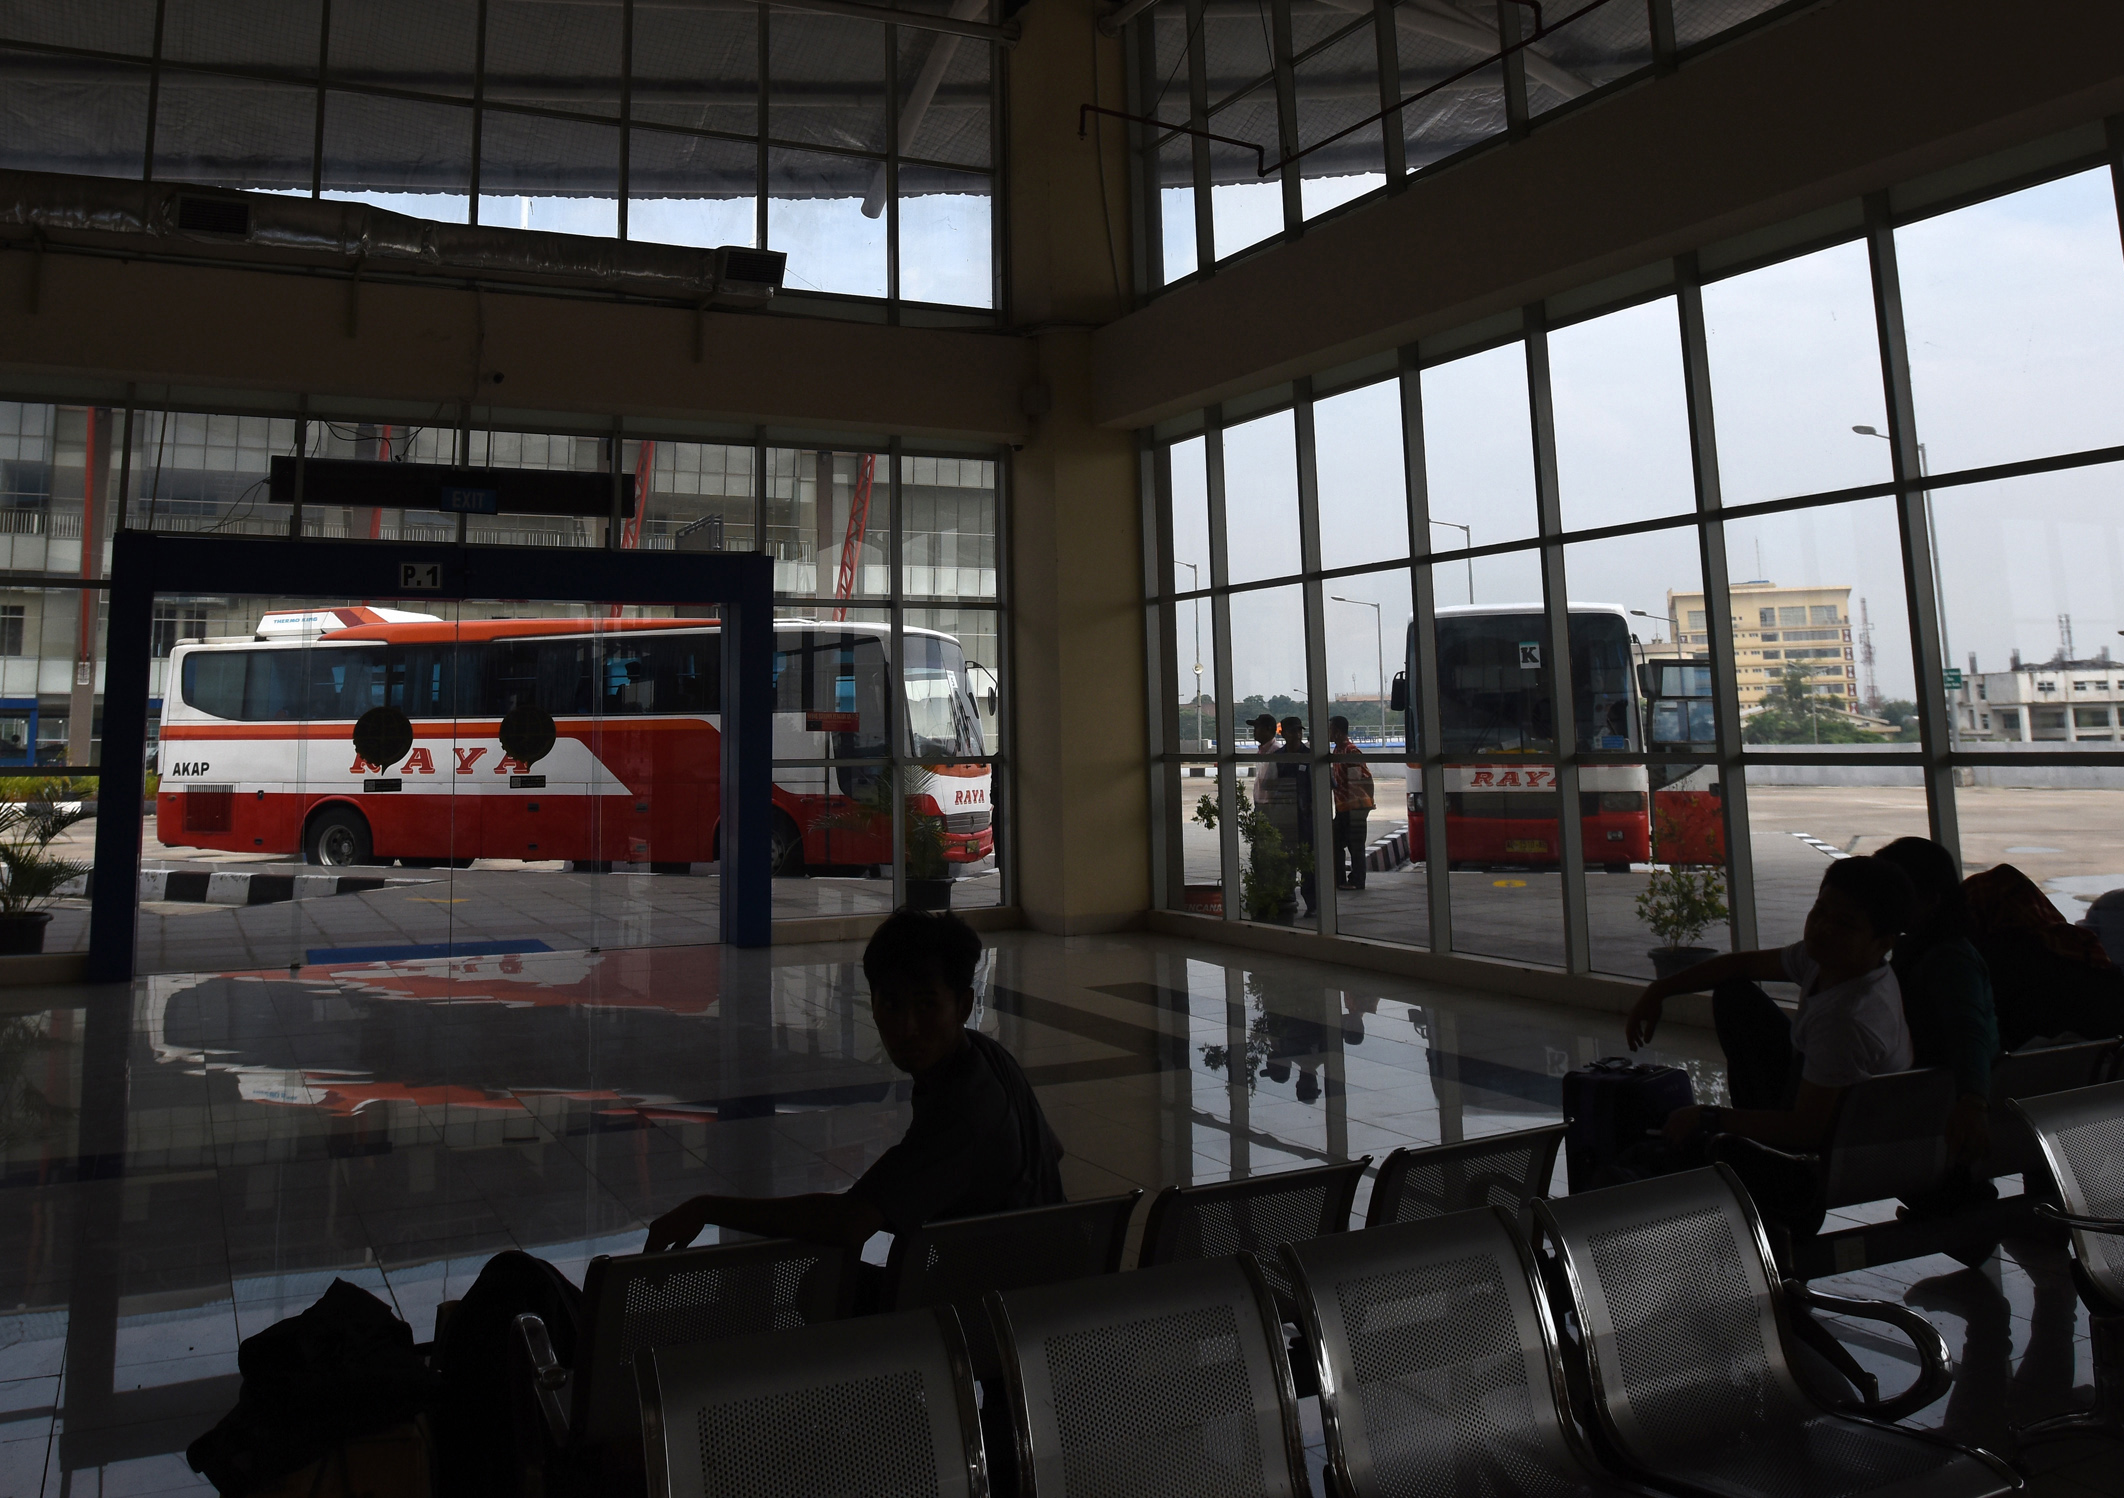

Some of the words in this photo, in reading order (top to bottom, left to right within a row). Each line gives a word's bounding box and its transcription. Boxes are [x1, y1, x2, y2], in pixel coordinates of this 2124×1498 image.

[452, 490, 485, 509] EXIT
[403, 565, 438, 587] P.1
[1520, 646, 1539, 664] K
[172, 762, 210, 777] AKAP
[955, 789, 985, 806] RAYA
